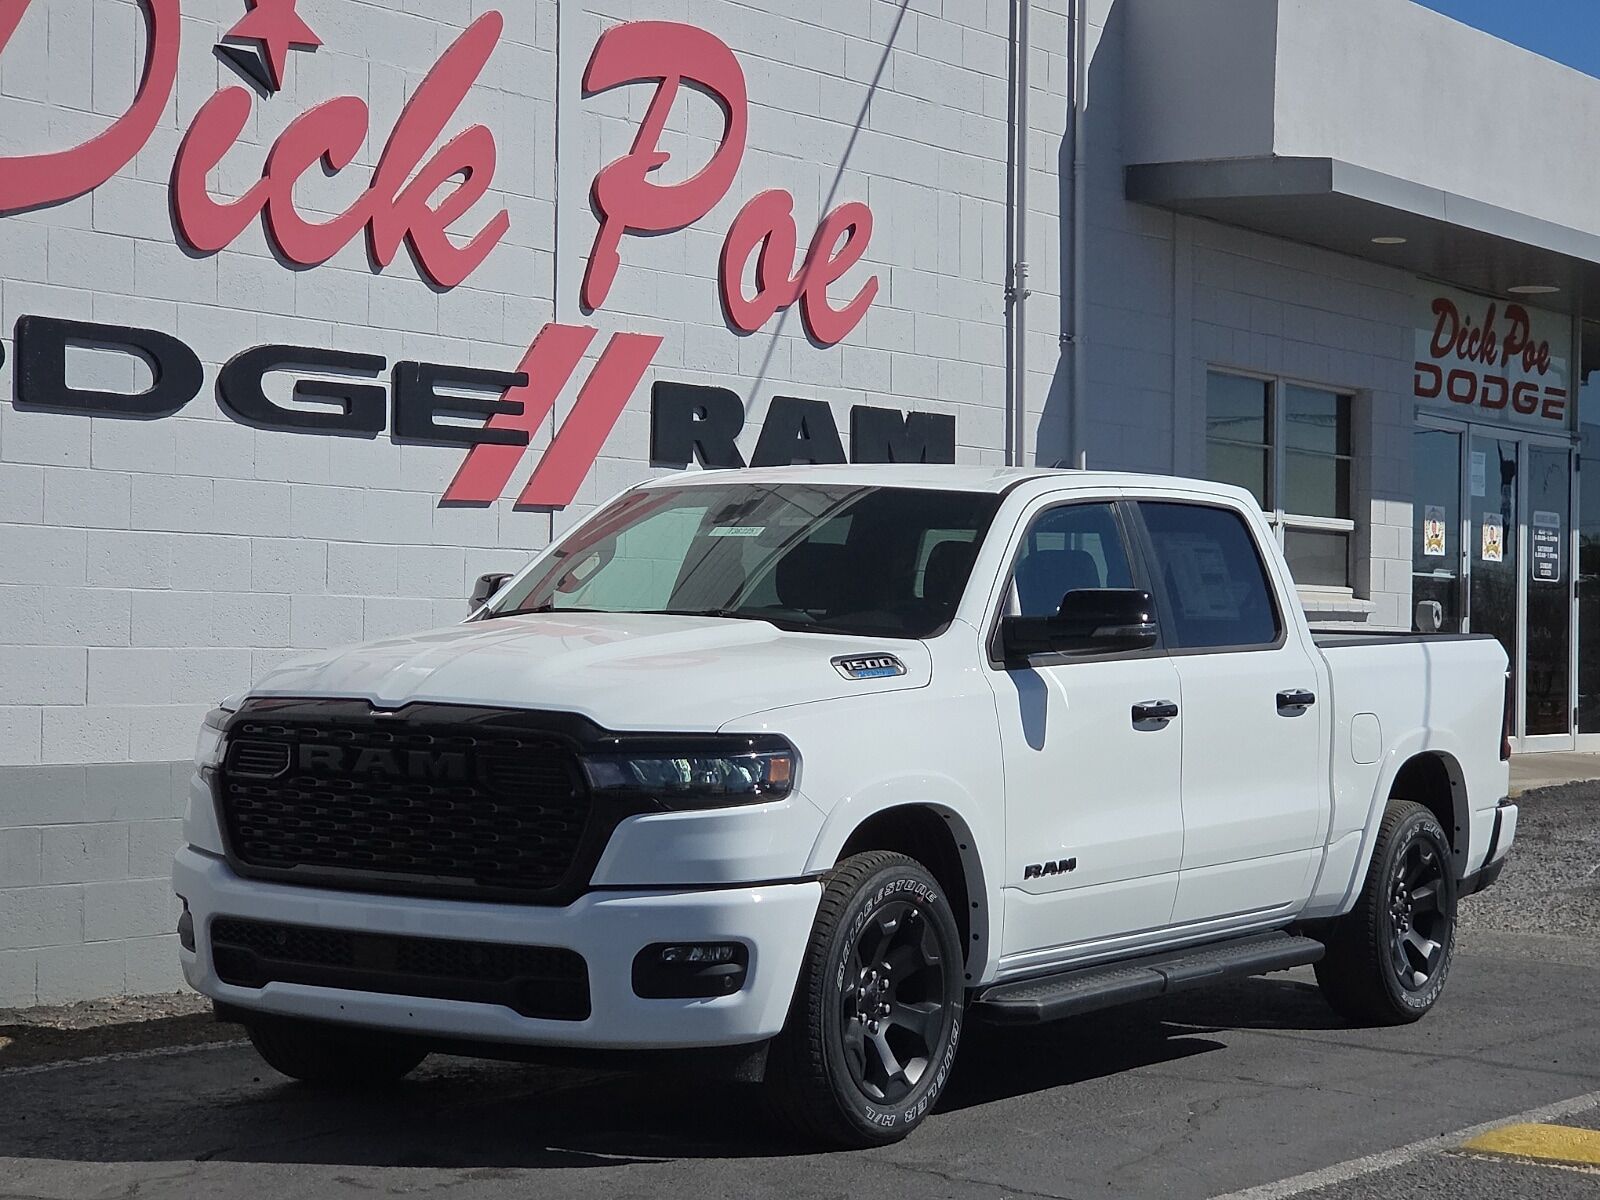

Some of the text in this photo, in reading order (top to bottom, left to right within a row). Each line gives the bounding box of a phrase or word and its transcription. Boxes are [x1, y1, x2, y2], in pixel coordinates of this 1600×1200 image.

[580, 20, 879, 346] Poe
[1430, 297, 1551, 375] Dick Poe
[0, 314, 955, 468] DGE RAM
[1414, 361, 1567, 420] DODGE
[843, 657, 893, 671] 1500
[299, 744, 468, 779] RAM
[1023, 857, 1077, 880] RAM
[836, 879, 937, 992] BRIDGESTONE
[865, 1105, 896, 1127] H/L
